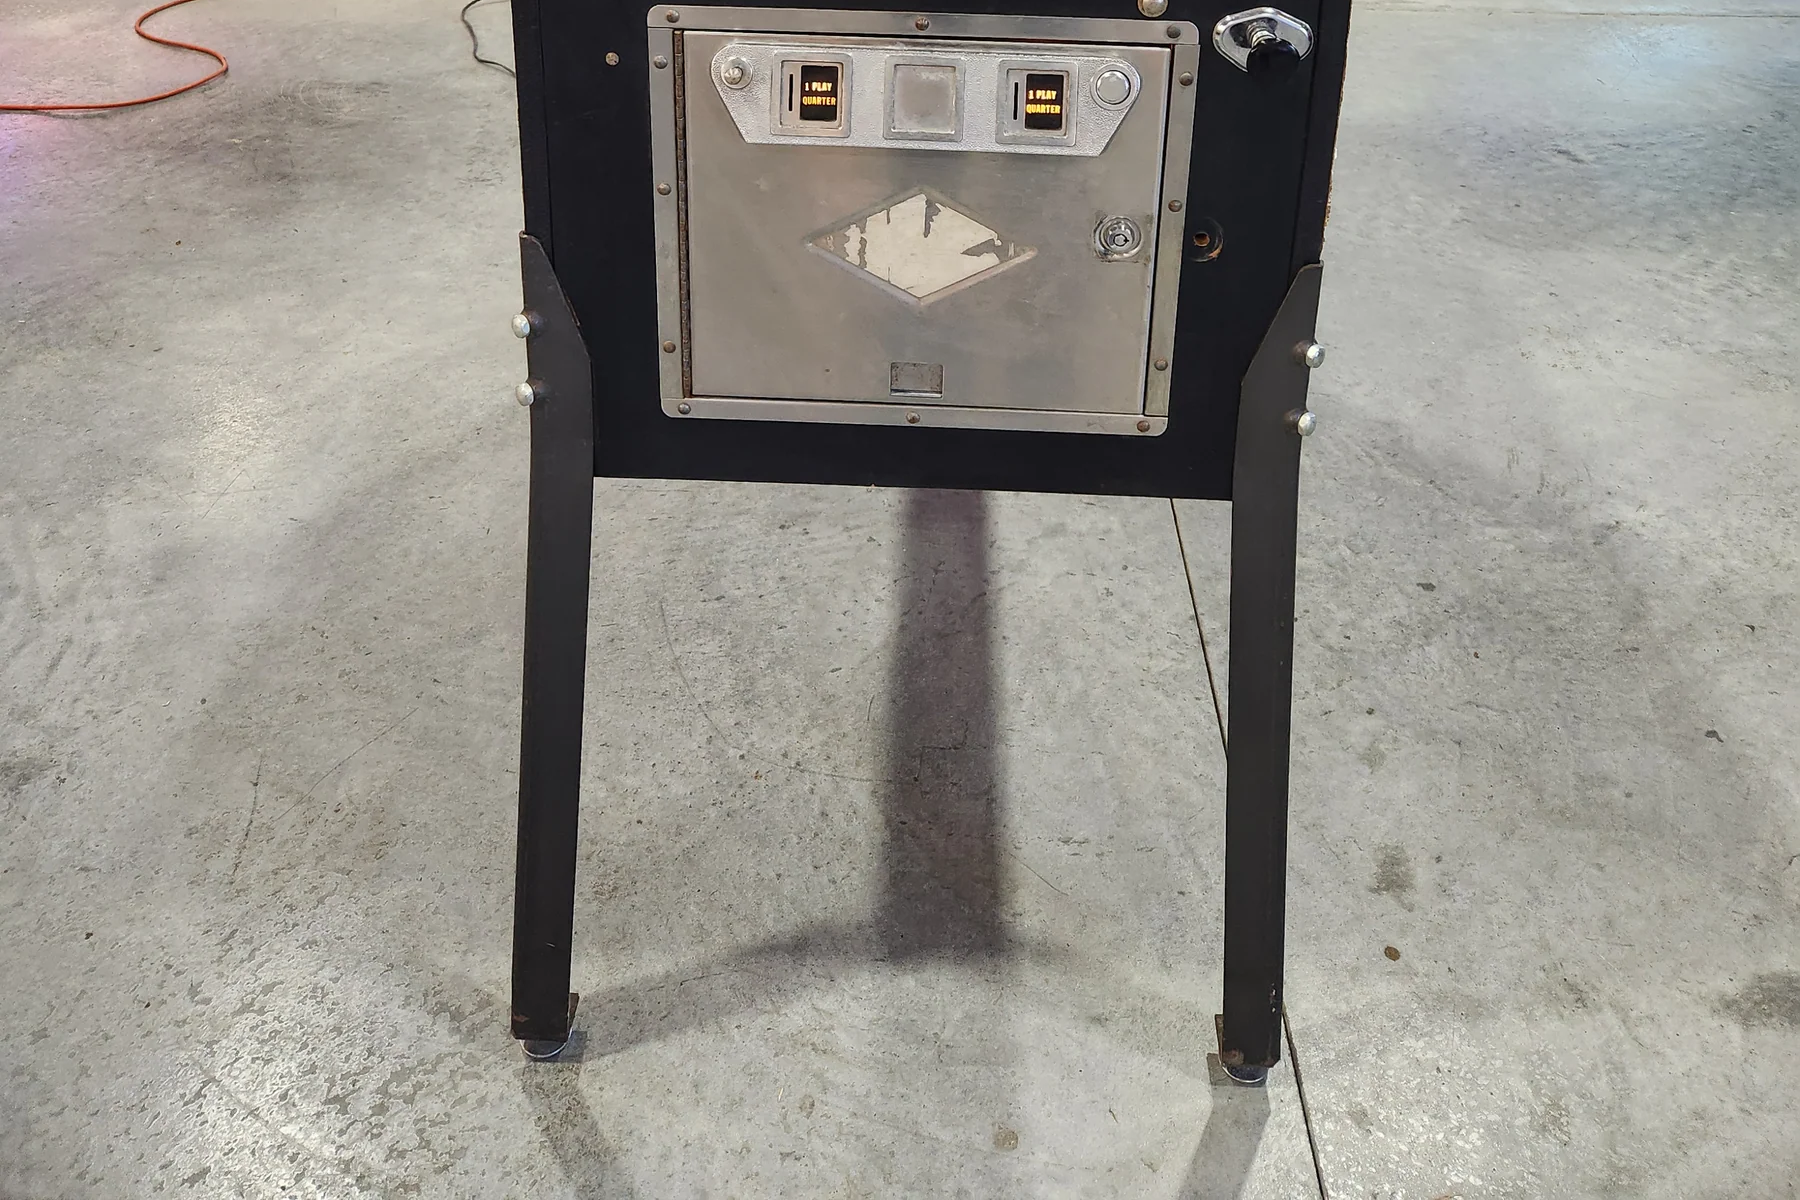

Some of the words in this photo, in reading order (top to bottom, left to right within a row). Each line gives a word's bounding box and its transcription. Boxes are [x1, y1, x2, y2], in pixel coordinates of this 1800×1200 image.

[812, 82, 832, 91] PLAY
[1028, 90, 1034, 99] 1
[1036, 90, 1056, 99] PLAY
[802, 96, 836, 105] QUARTER
[1026, 104, 1060, 114] QUARTER
